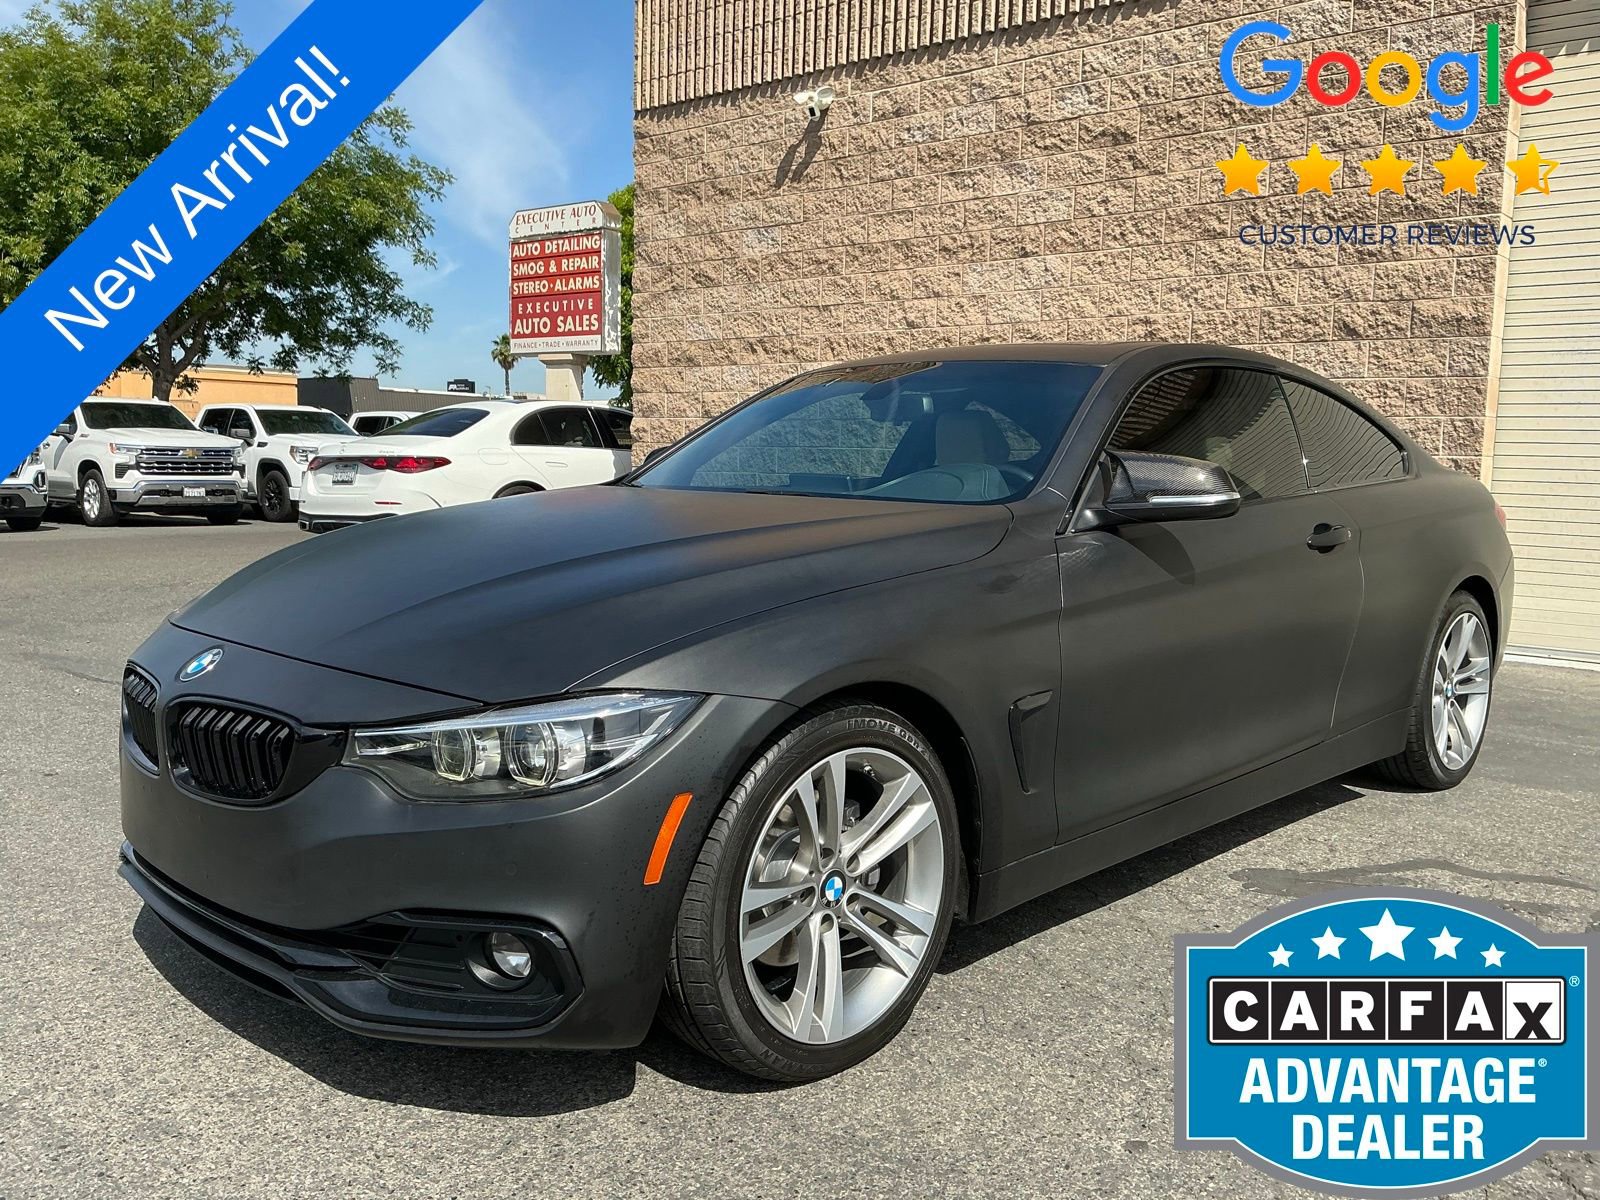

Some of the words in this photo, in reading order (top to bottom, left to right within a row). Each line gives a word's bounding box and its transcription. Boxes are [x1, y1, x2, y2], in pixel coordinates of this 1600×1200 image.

[515, 208, 566, 226] EXECUTIVE
[570, 204, 597, 219] AUTO
[512, 243, 541, 258] AUTO
[544, 235, 601, 254] DETAILING
[513, 261, 545, 277] SMOG
[549, 260, 557, 273] &
[561, 255, 600, 272] REPAIR
[518, 298, 594, 315] EXECUTIVE
[513, 316, 551, 335] AUTO
[556, 314, 599, 332] SALES
